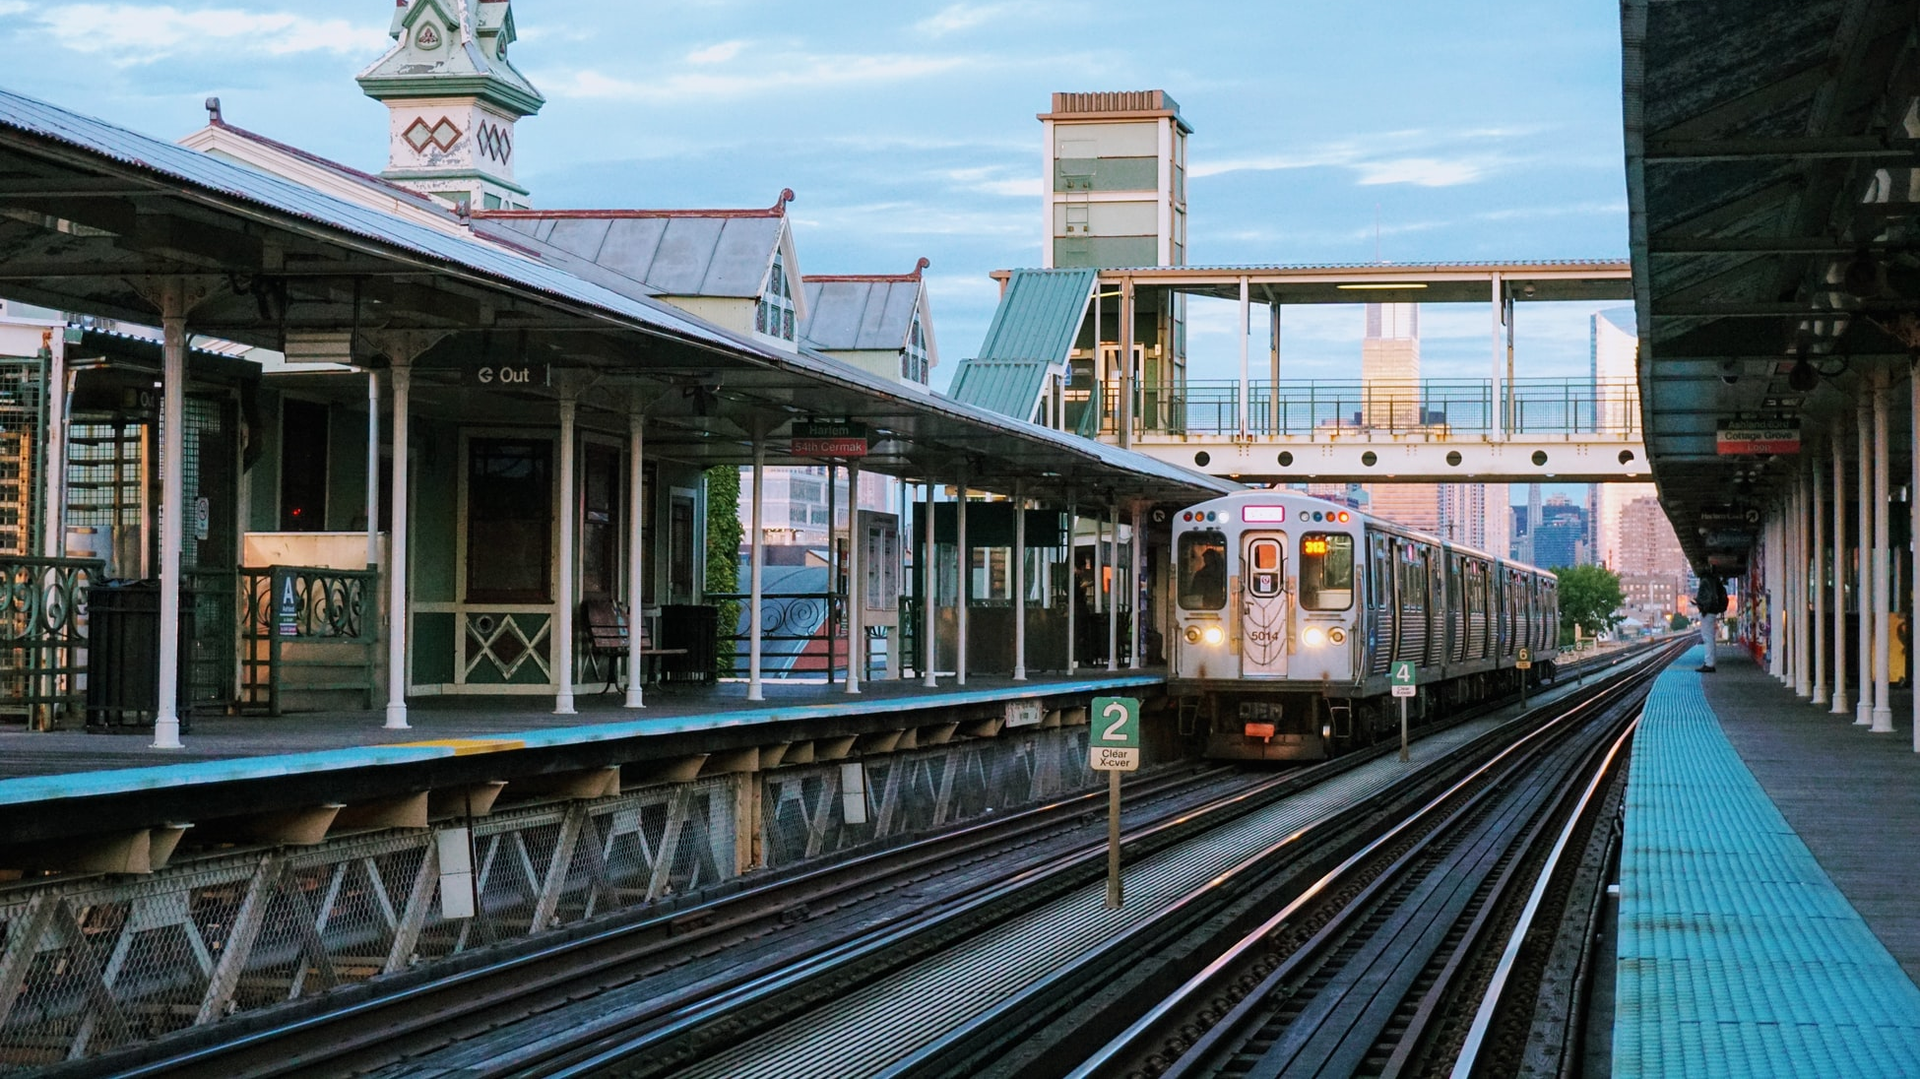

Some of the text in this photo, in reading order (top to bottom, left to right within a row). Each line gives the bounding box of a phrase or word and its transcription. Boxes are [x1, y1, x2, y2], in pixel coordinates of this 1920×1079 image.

[500, 366, 530, 383] Out
[809, 425, 849, 436] Harlem
[1725, 431, 1793, 441] Cottage Grove
[821, 441, 862, 452] Cermak
[283, 576, 294, 604] A
[1251, 631, 1279, 641] 5014
[1519, 648, 1528, 660] 6
[1396, 664, 1410, 682] 4
[1102, 702, 1129, 741] 2
[1102, 749, 1128, 759] Clear
